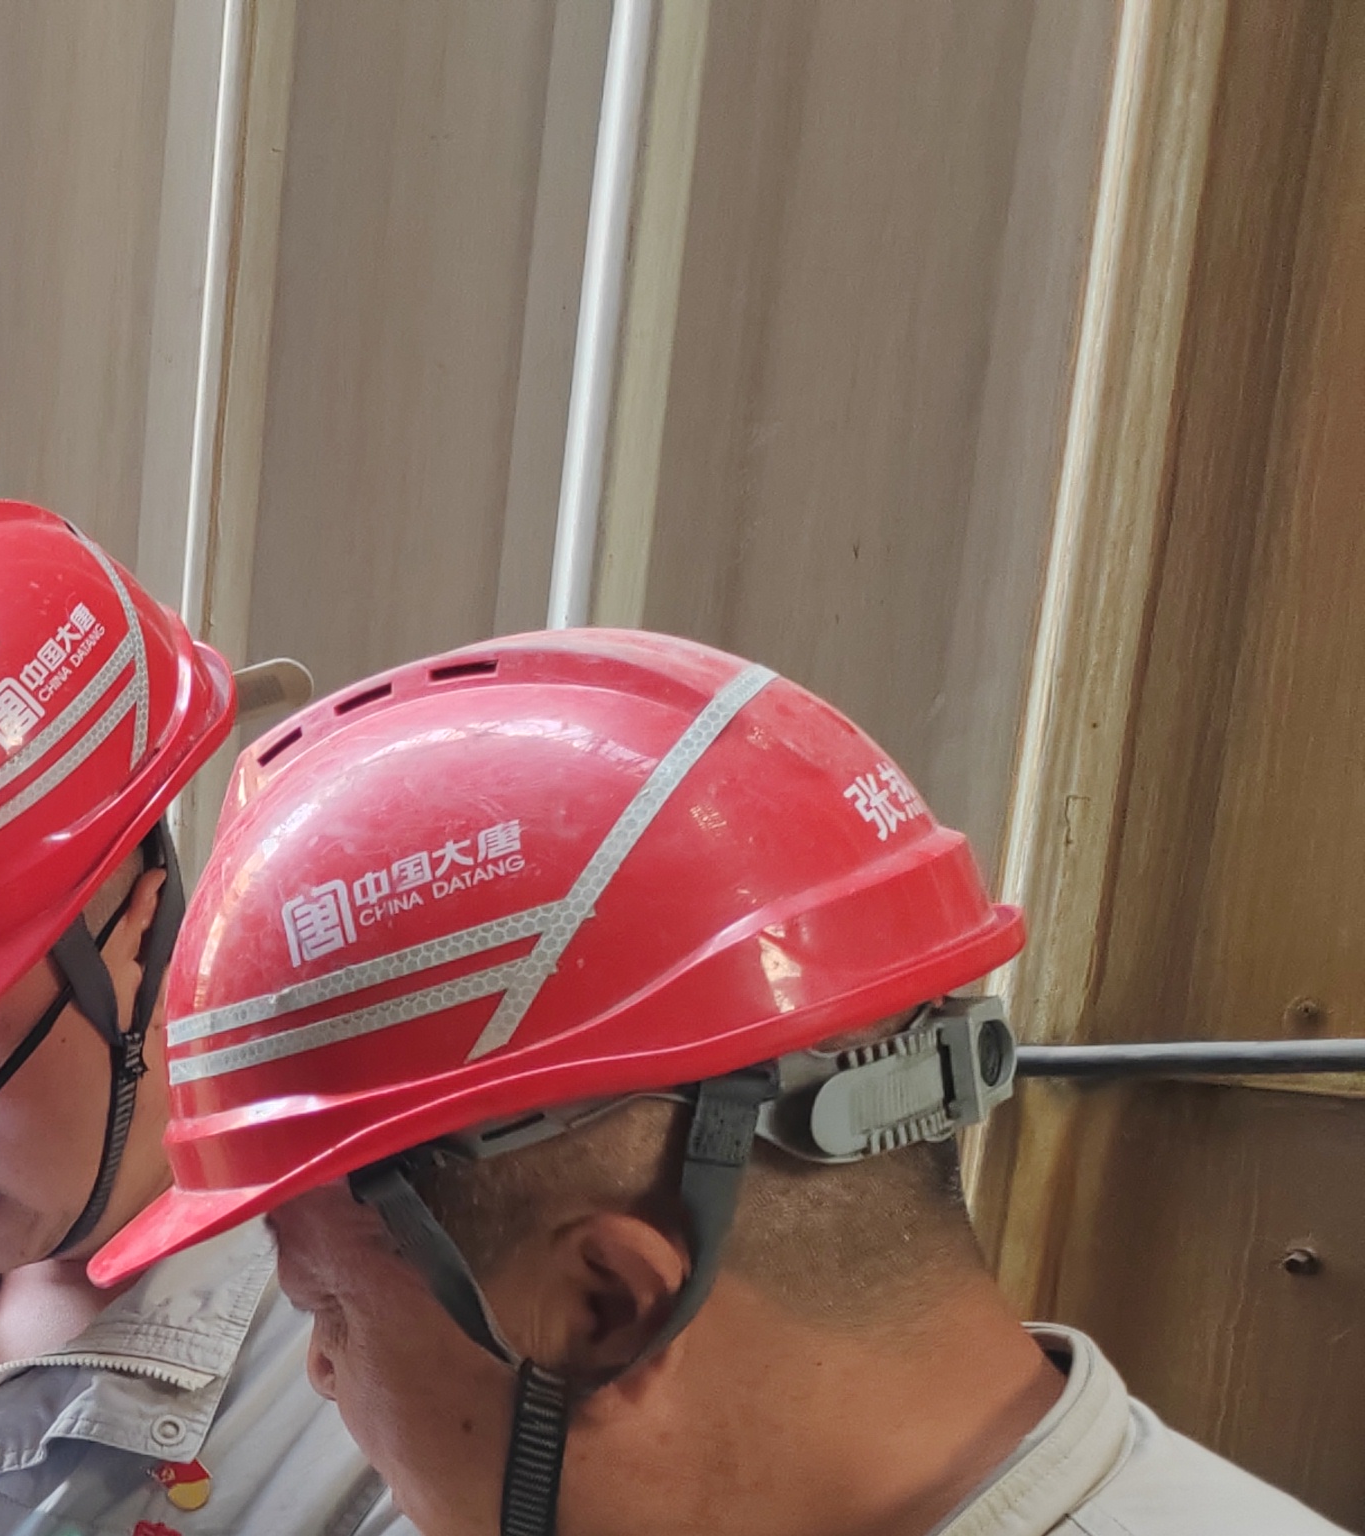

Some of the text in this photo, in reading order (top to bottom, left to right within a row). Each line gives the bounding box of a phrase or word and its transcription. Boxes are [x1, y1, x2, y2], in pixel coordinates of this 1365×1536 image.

[20, 602, 96, 691] 中国大唐
[38, 622, 106, 702] CHINA DATANG
[353, 819, 522, 906] 中国大唐
[359, 854, 526, 927] CHINA DATANG
